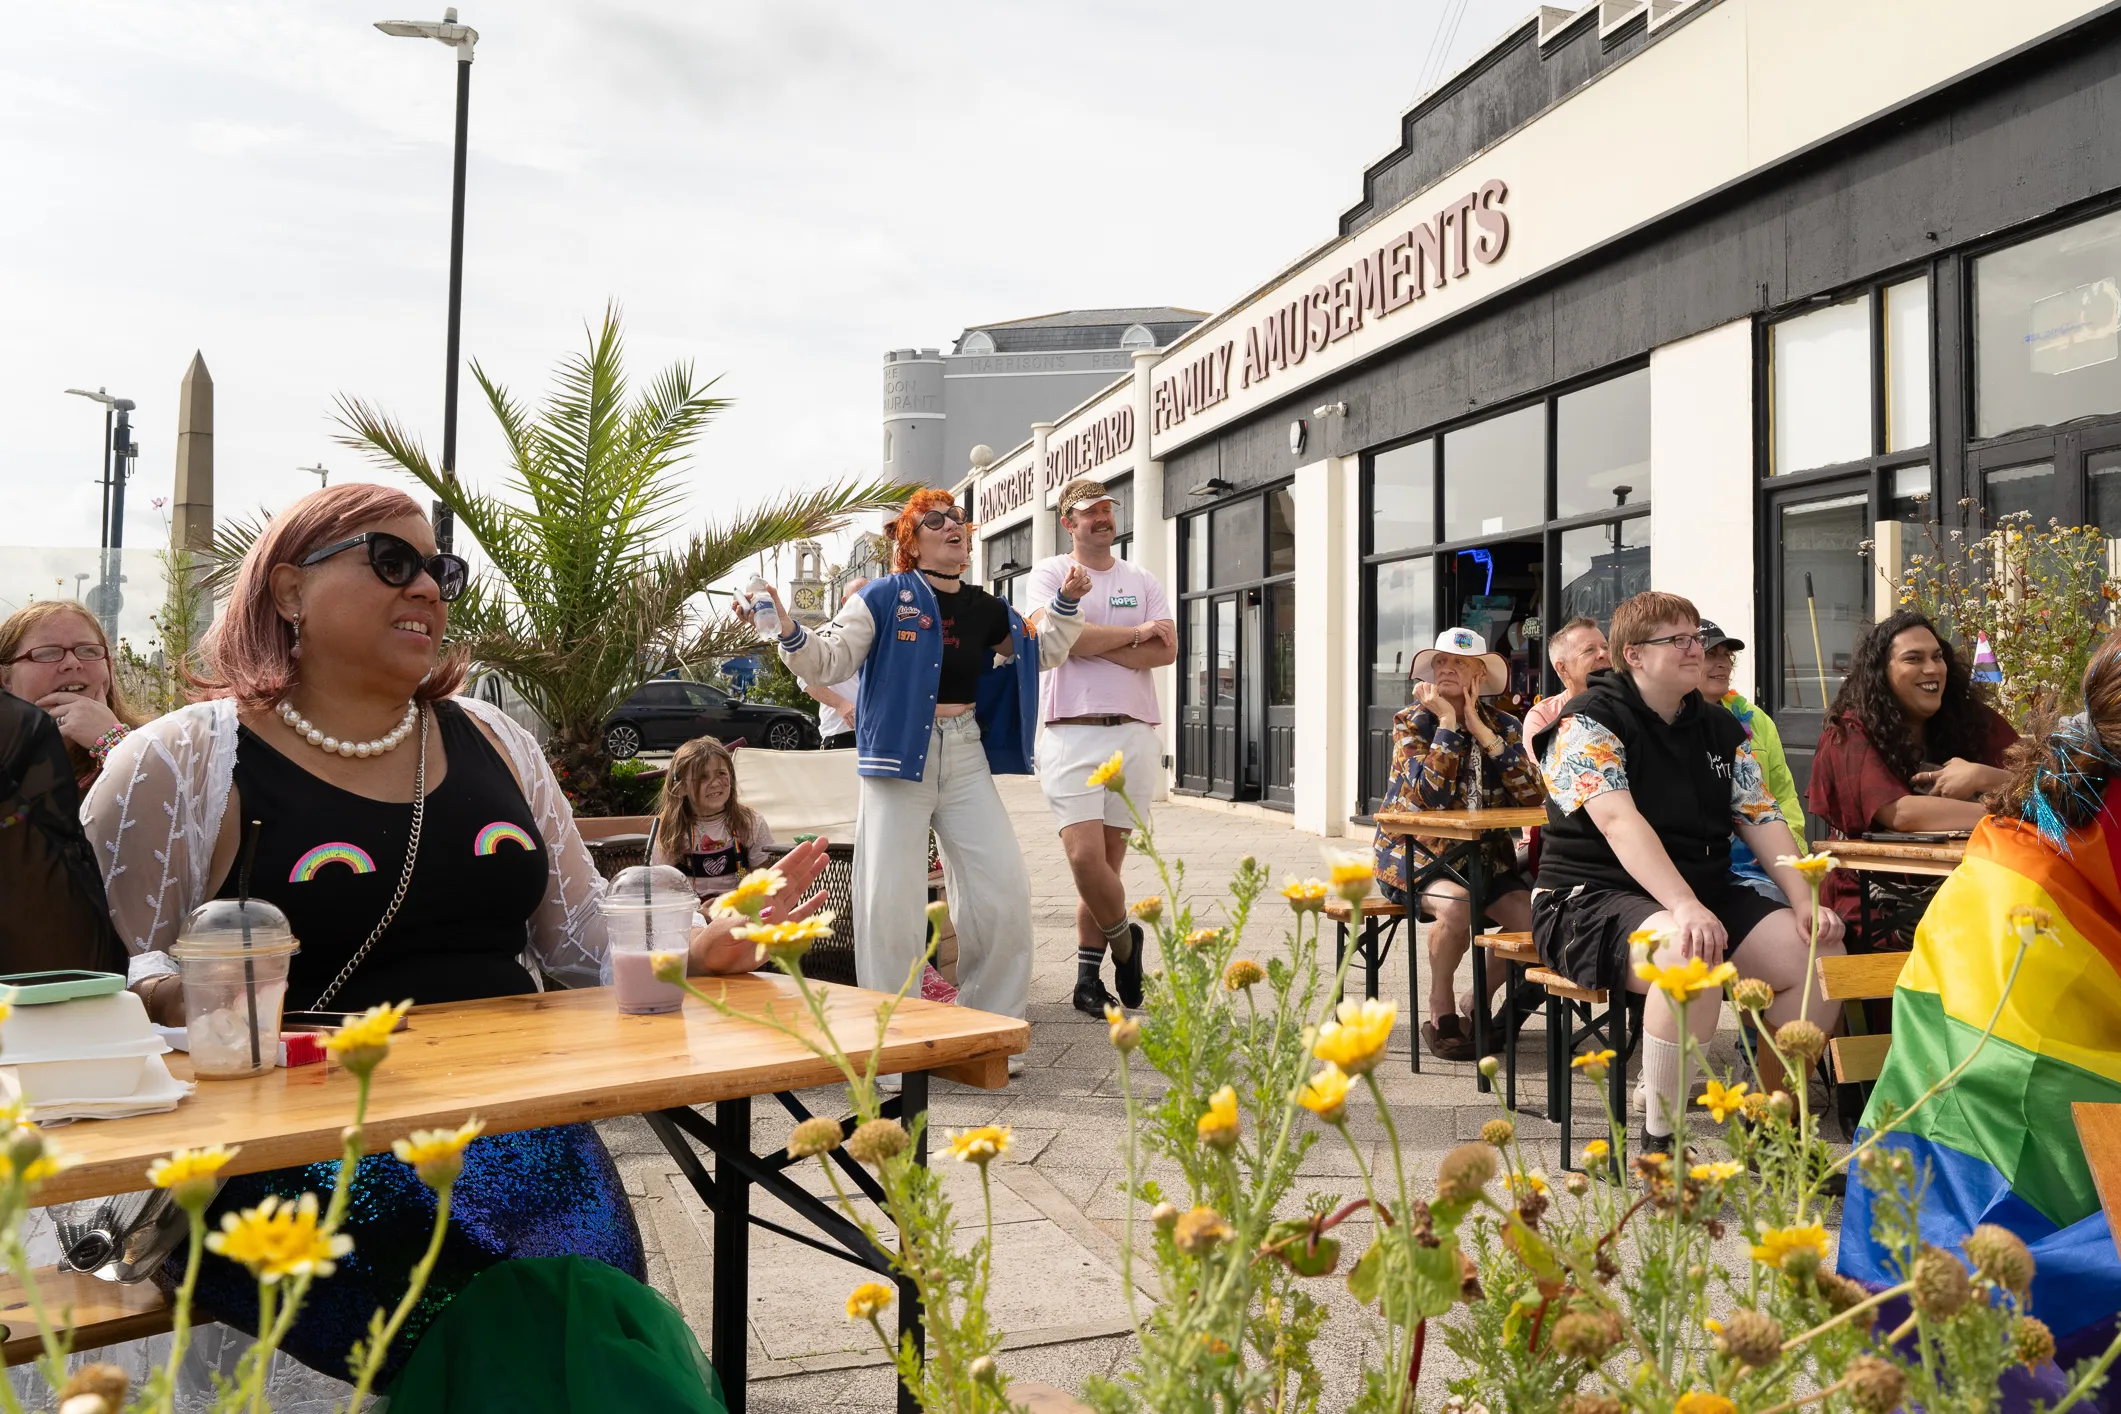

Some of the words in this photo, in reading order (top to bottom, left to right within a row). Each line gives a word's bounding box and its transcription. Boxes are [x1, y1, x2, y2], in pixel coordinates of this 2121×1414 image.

[980, 460, 1034, 525] RAMSGATE
[1045, 403, 1135, 493] BOULEVARD
[1152, 340, 1234, 436] FAMILY
[1240, 178, 1510, 389] AMUSEMENTS
[970, 356, 1067, 373] HARRISON'S
[884, 367, 899, 380] HE
[1110, 596, 1138, 606] HOPE
[897, 630, 917, 642] 1979
